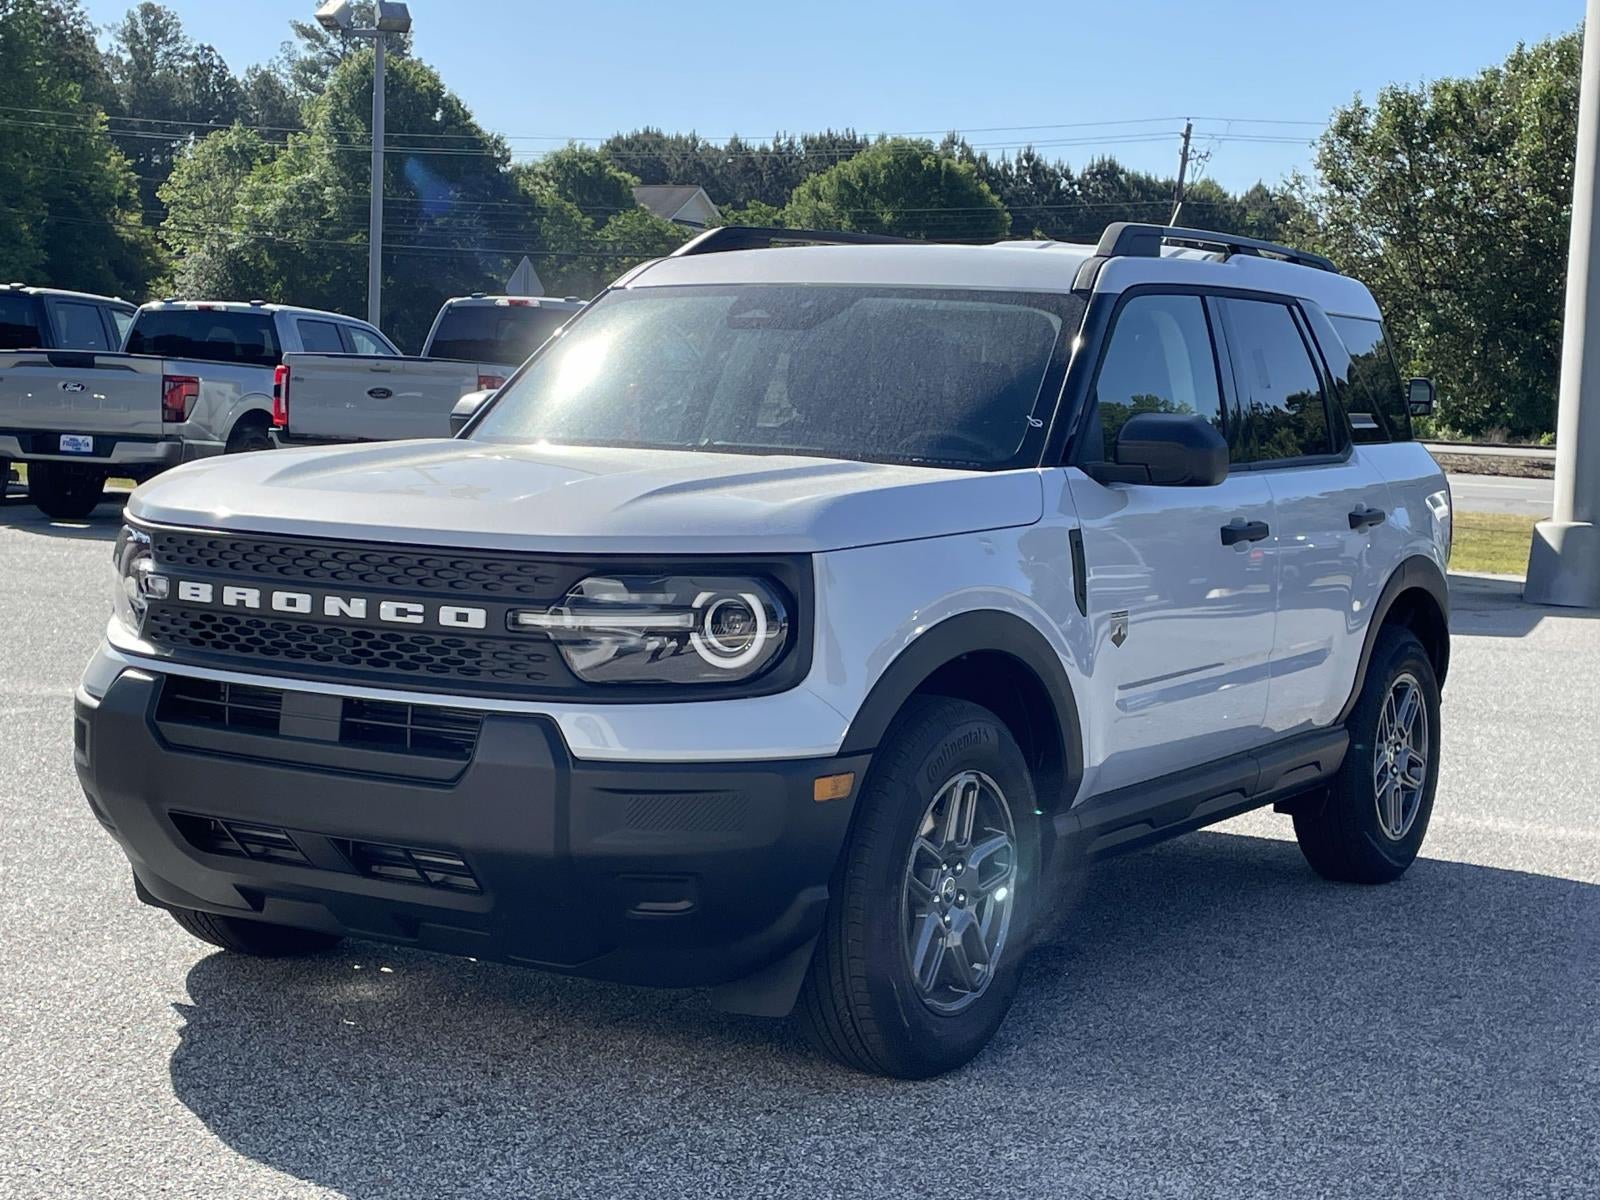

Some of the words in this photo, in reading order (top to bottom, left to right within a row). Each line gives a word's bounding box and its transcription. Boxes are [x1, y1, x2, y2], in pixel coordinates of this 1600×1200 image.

[63, 382, 85, 392] Ford
[178, 580, 487, 630] BRONCO
[926, 727, 981, 784] Continental
